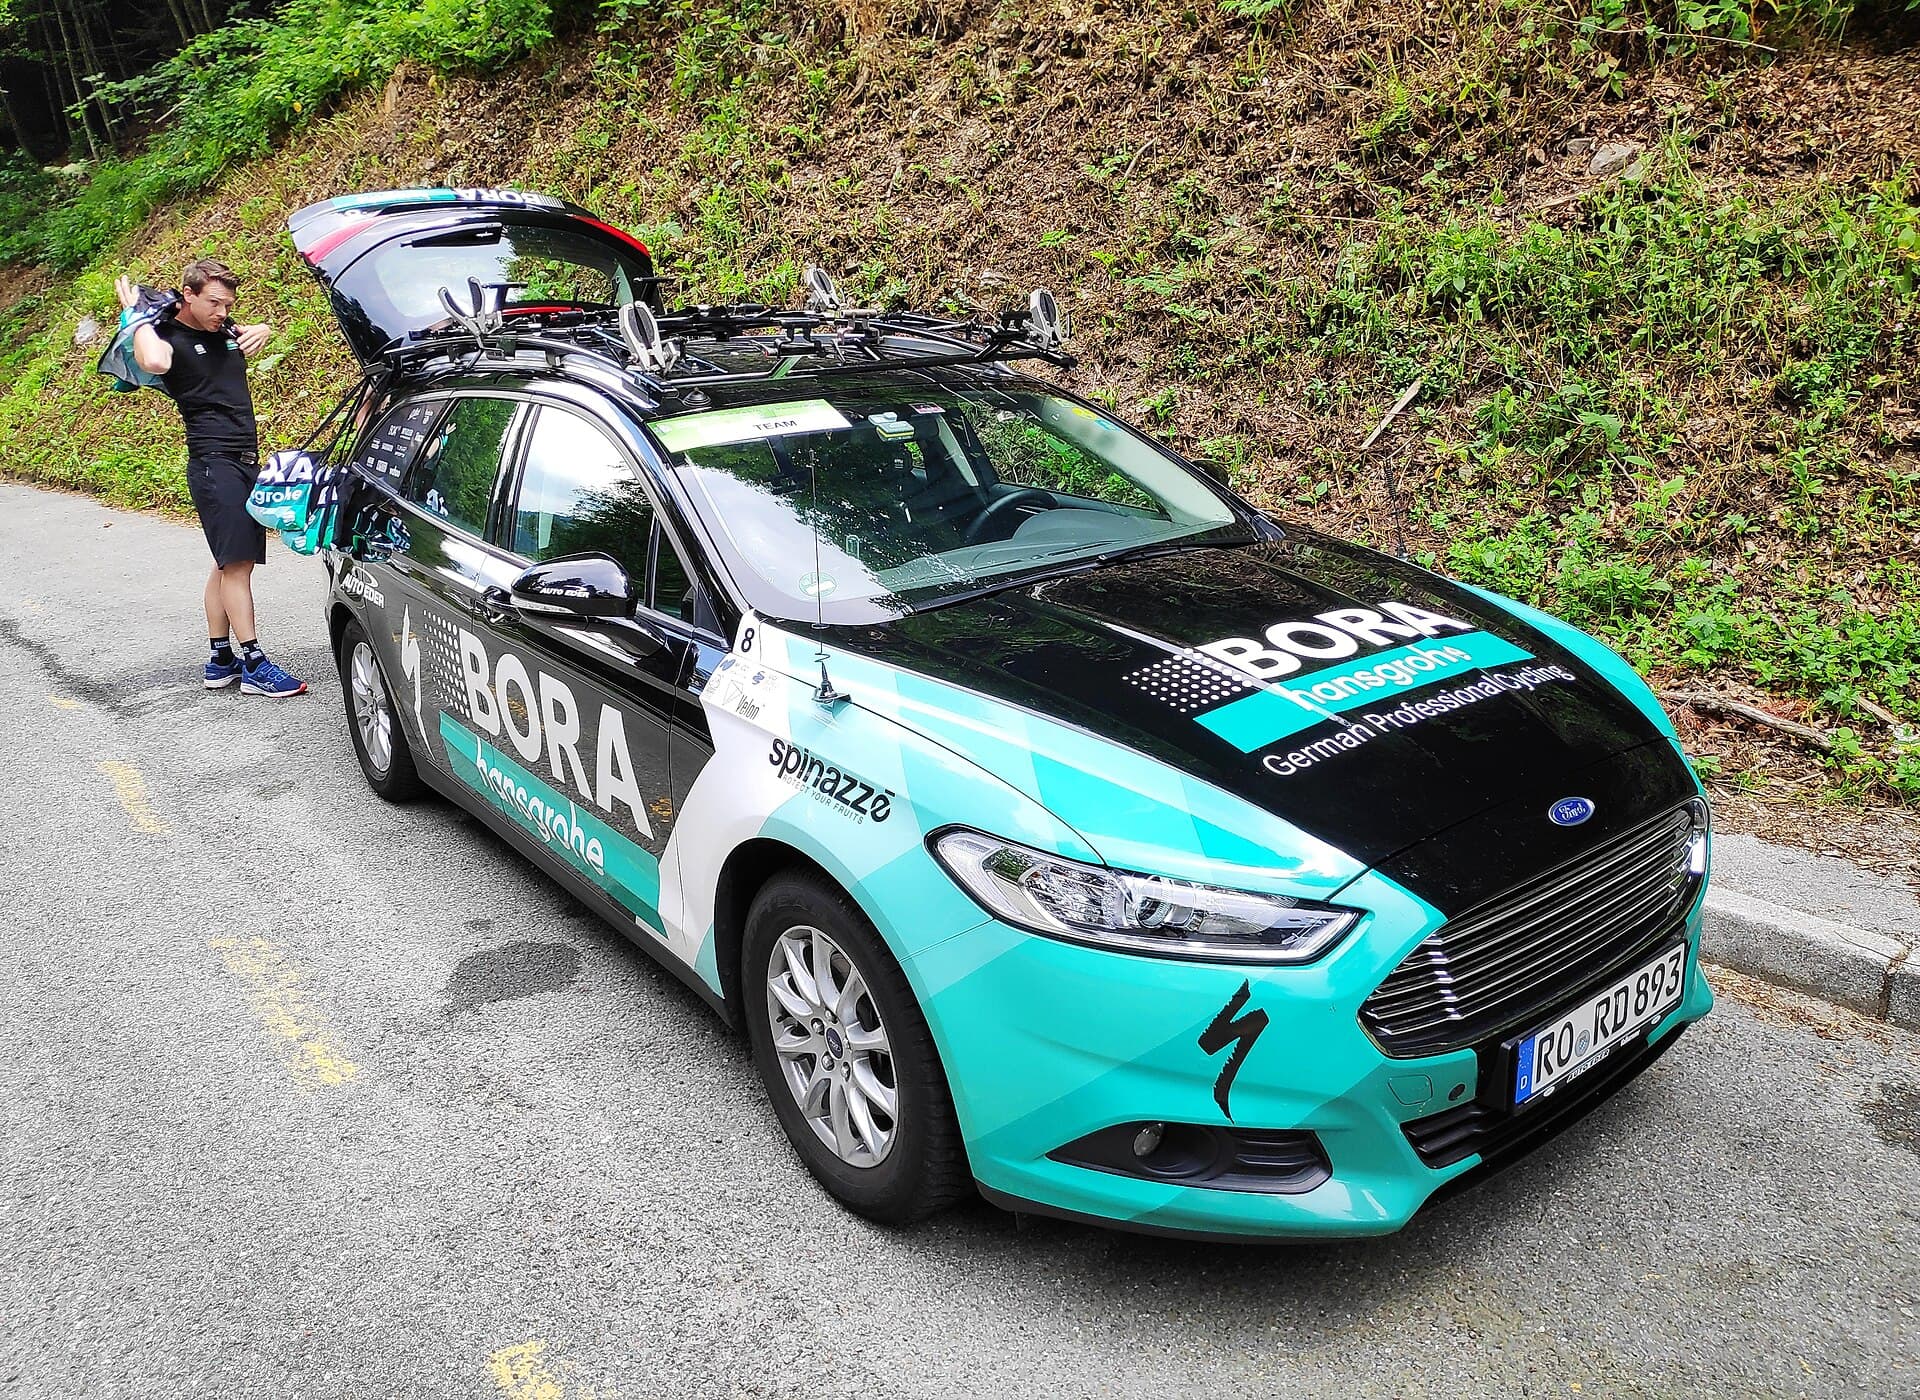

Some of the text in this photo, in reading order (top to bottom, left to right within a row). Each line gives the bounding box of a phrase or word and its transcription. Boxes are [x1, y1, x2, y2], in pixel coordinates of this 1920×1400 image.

[753, 420, 798, 431] TEAM
[340, 572, 385, 609] AUTO EDER
[540, 587, 590, 598] AUTO EDER
[741, 627, 755, 653] 8
[1201, 601, 1476, 680] BORA
[1279, 644, 1472, 711] hansgrohe
[735, 695, 760, 720] Velon
[1262, 665, 1577, 776] German Professional Cycling
[459, 627, 654, 841] BORA
[475, 735, 606, 876] hansgrohe
[809, 789, 833, 808] YOUR
[833, 803, 864, 825] FRUITS
[1558, 802, 1587, 821] Ford
[1536, 951, 1681, 1084] RO RD 893
[1520, 1075, 1528, 1090] D
